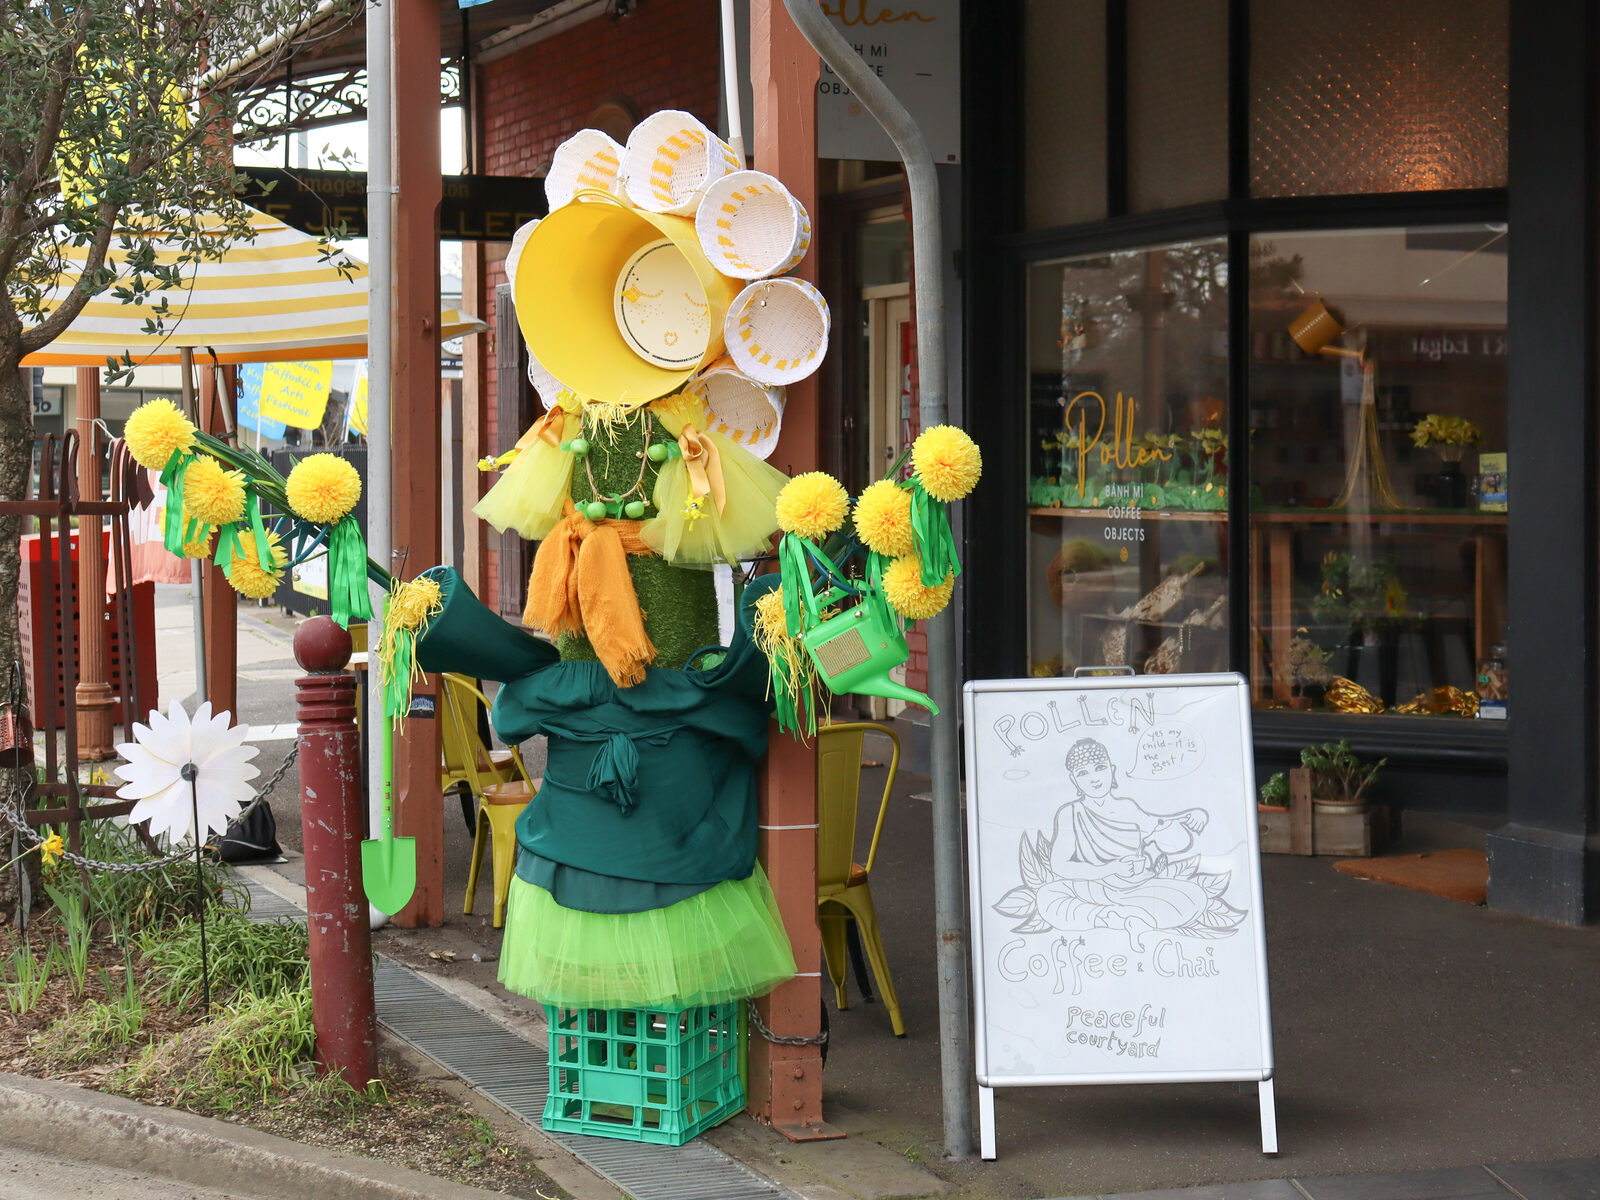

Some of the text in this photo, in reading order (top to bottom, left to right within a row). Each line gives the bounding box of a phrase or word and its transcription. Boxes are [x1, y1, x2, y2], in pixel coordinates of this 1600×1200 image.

[1065, 391, 1173, 499] Pollen
[1107, 505, 1143, 520] COFFEE
[1104, 526, 1146, 542] OBJECTS
[998, 936, 1128, 996] Coffee
[1152, 938, 1220, 978] Chai
[1066, 1030, 1162, 1059] courtyard
